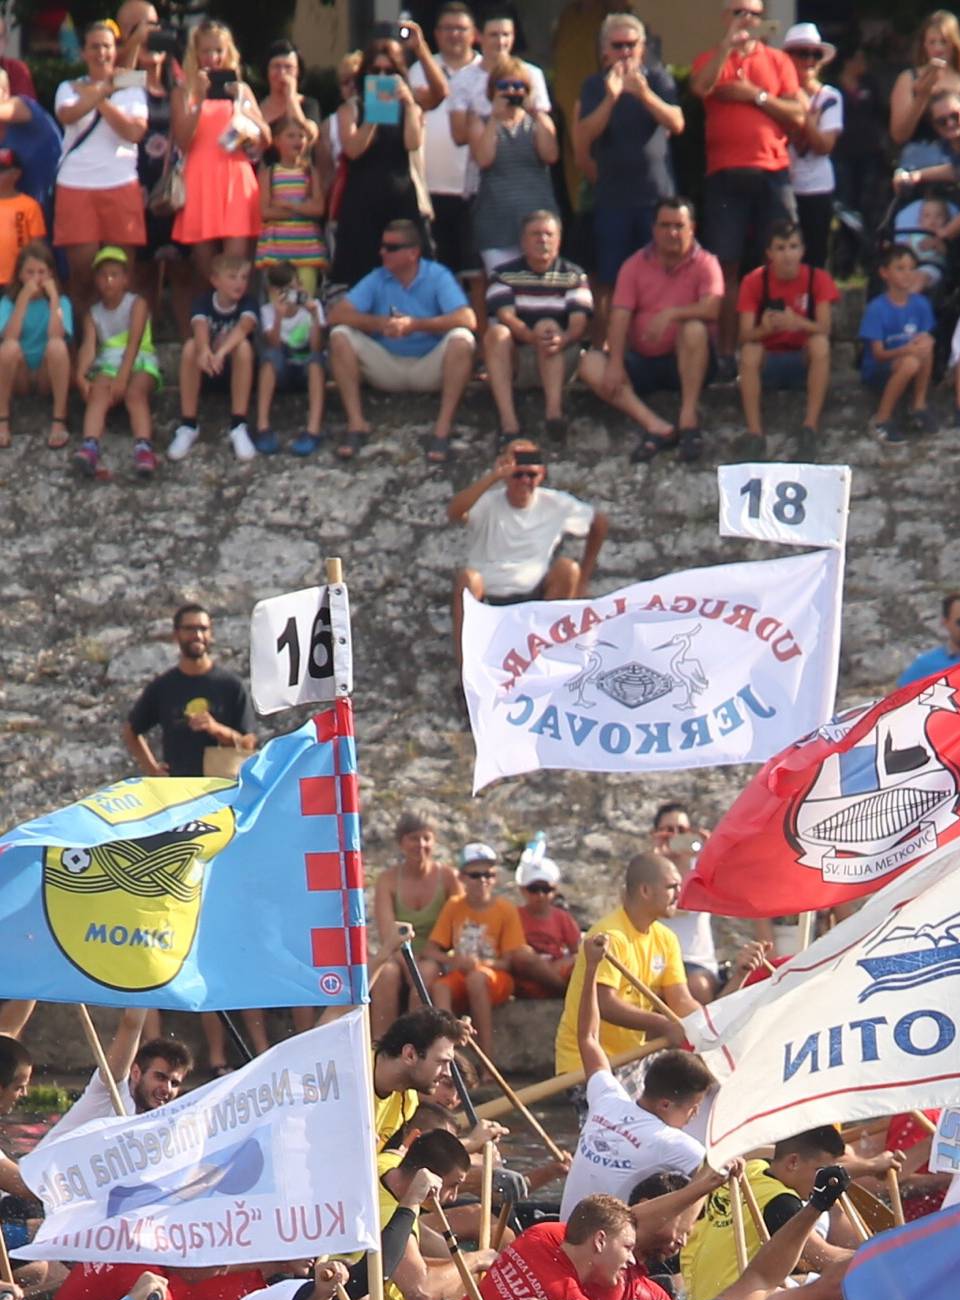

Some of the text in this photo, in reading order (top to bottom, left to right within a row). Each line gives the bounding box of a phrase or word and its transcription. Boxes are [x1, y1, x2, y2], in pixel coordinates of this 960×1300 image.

[740, 478, 807, 525] 18
[276, 607, 335, 687] 16
[824, 829, 936, 876] SV. ILIJA METKOVIĆ
